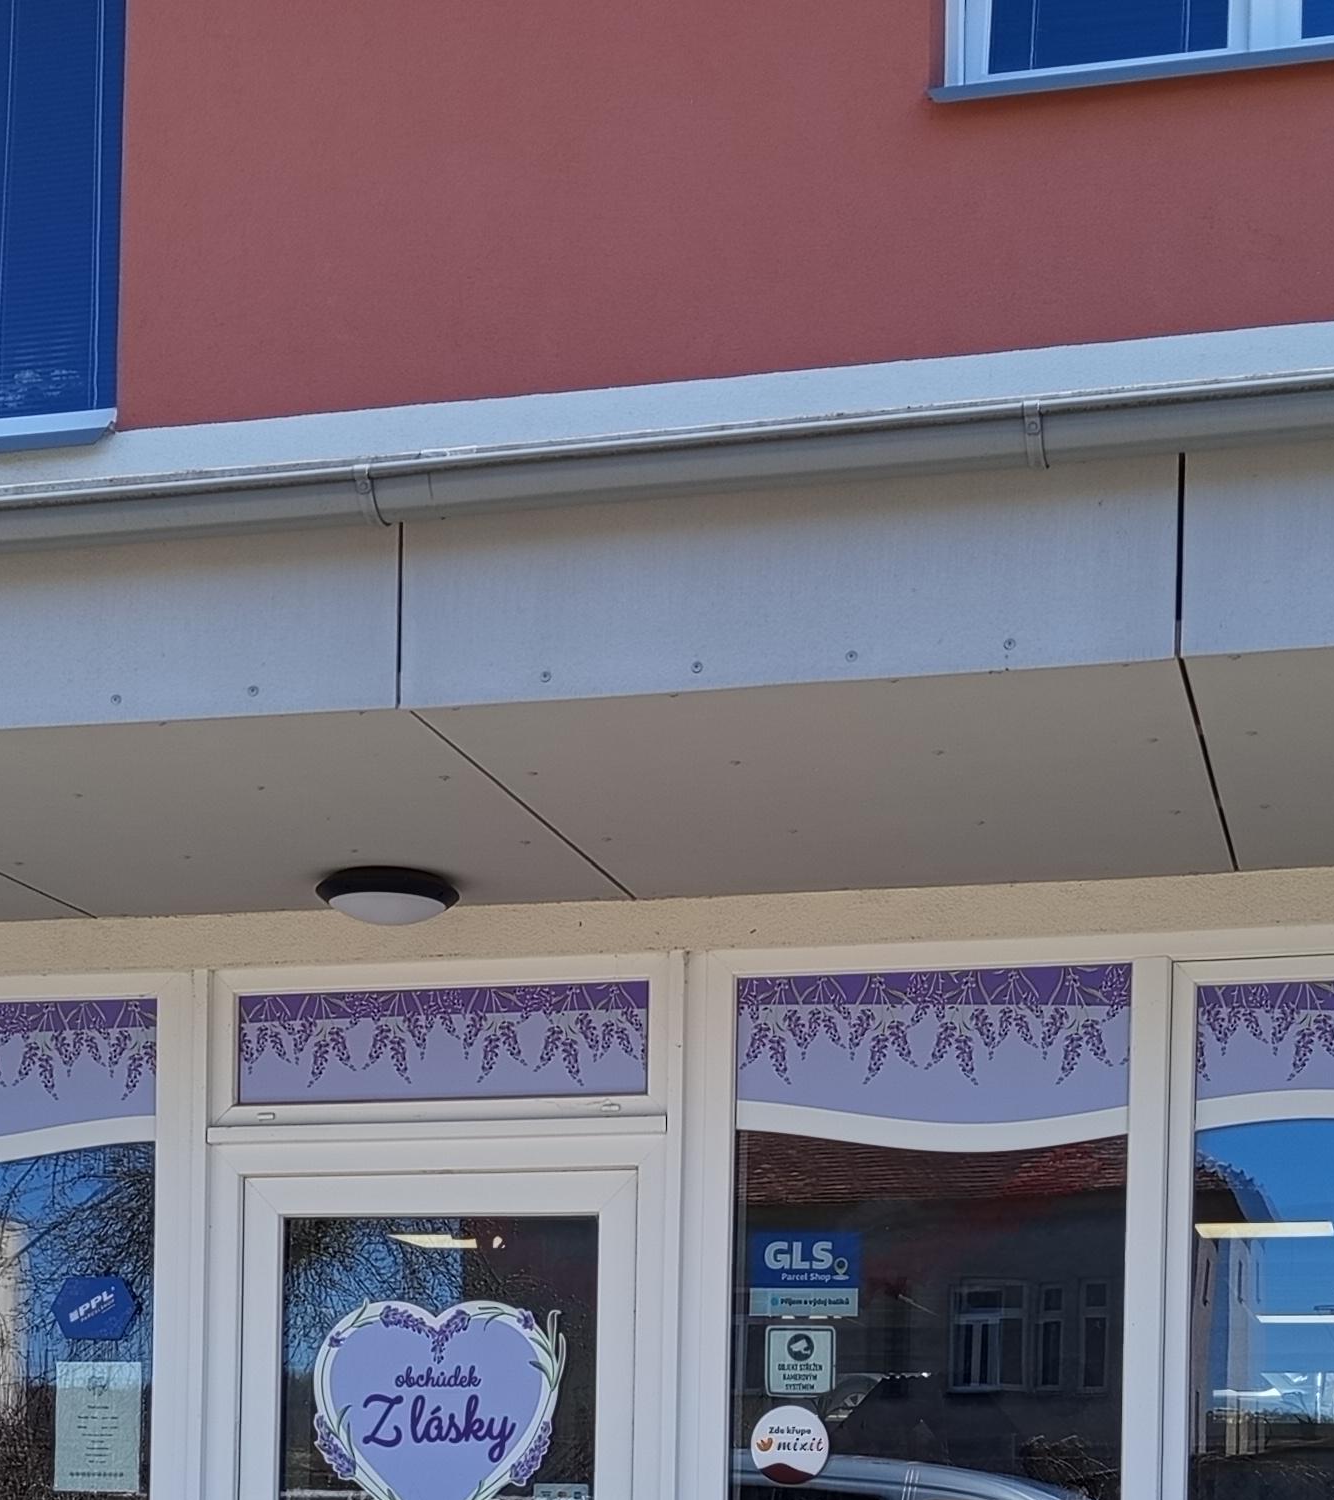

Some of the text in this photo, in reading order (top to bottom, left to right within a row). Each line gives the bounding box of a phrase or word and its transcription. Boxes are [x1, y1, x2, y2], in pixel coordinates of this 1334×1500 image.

[764, 1241, 834, 1270] GLS
[781, 1272, 832, 1283] Parcel Shop
[78, 1290, 115, 1317] PPL
[395, 1365, 482, 1388] obchůdek
[777, 1363, 798, 1371] OBJEKT
[362, 1394, 516, 1463] Z lásky
[768, 1426, 785, 1434] Zde
[776, 1437, 824, 1452] mixit
